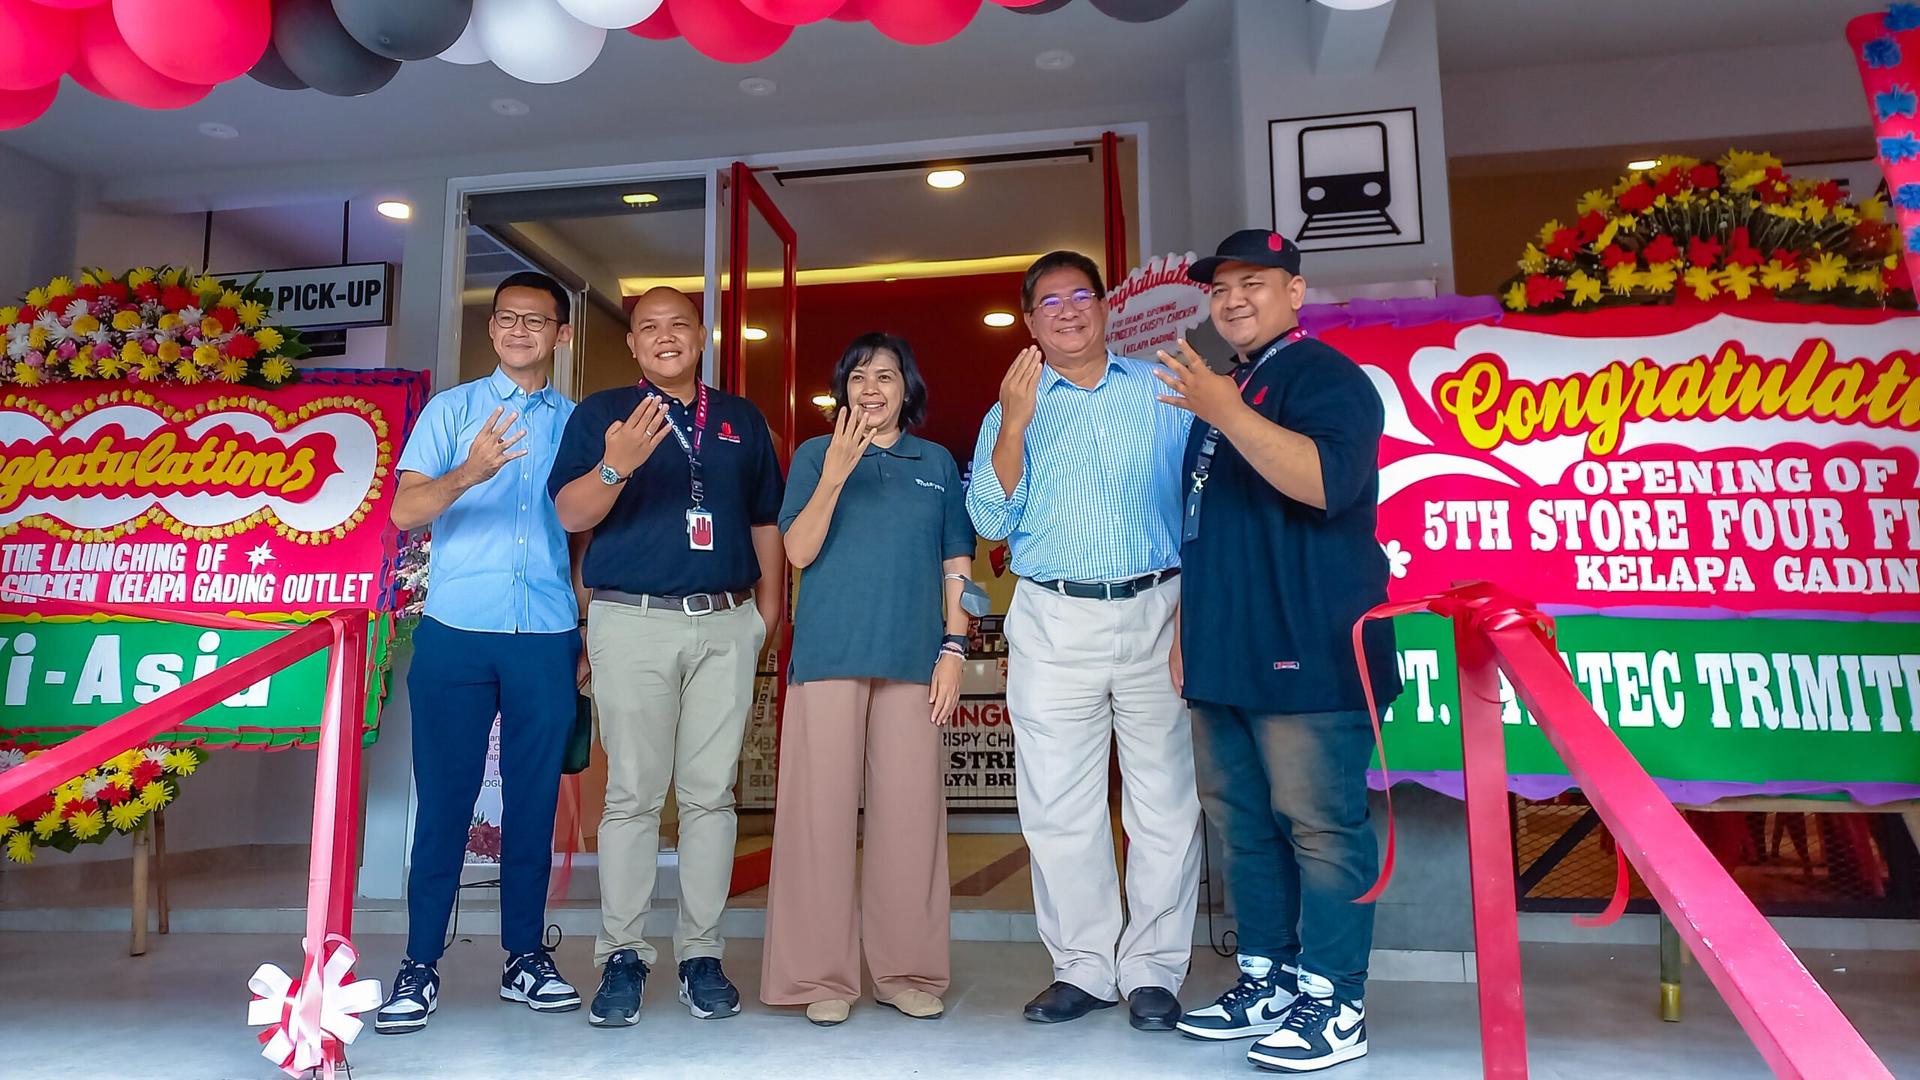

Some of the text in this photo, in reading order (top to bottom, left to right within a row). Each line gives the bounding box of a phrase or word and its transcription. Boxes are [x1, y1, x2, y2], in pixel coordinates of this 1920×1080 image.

[278, 279, 382, 312] PICK-UP
[1140, 316, 1167, 334] CRISPY
[1166, 305, 1199, 324] CHICKEN
[1574, 457, 1898, 495] OPENING OF
[1424, 500, 1513, 551] 5TH
[1527, 499, 1690, 552] STORE
[1712, 498, 1849, 551] FOUR
[2, 543, 228, 573] THE LAUNCHING OF
[1574, 554, 1756, 594] KELAPA
[1, 573, 373, 604] CHICKEN KELAPA GADING OUTLET
